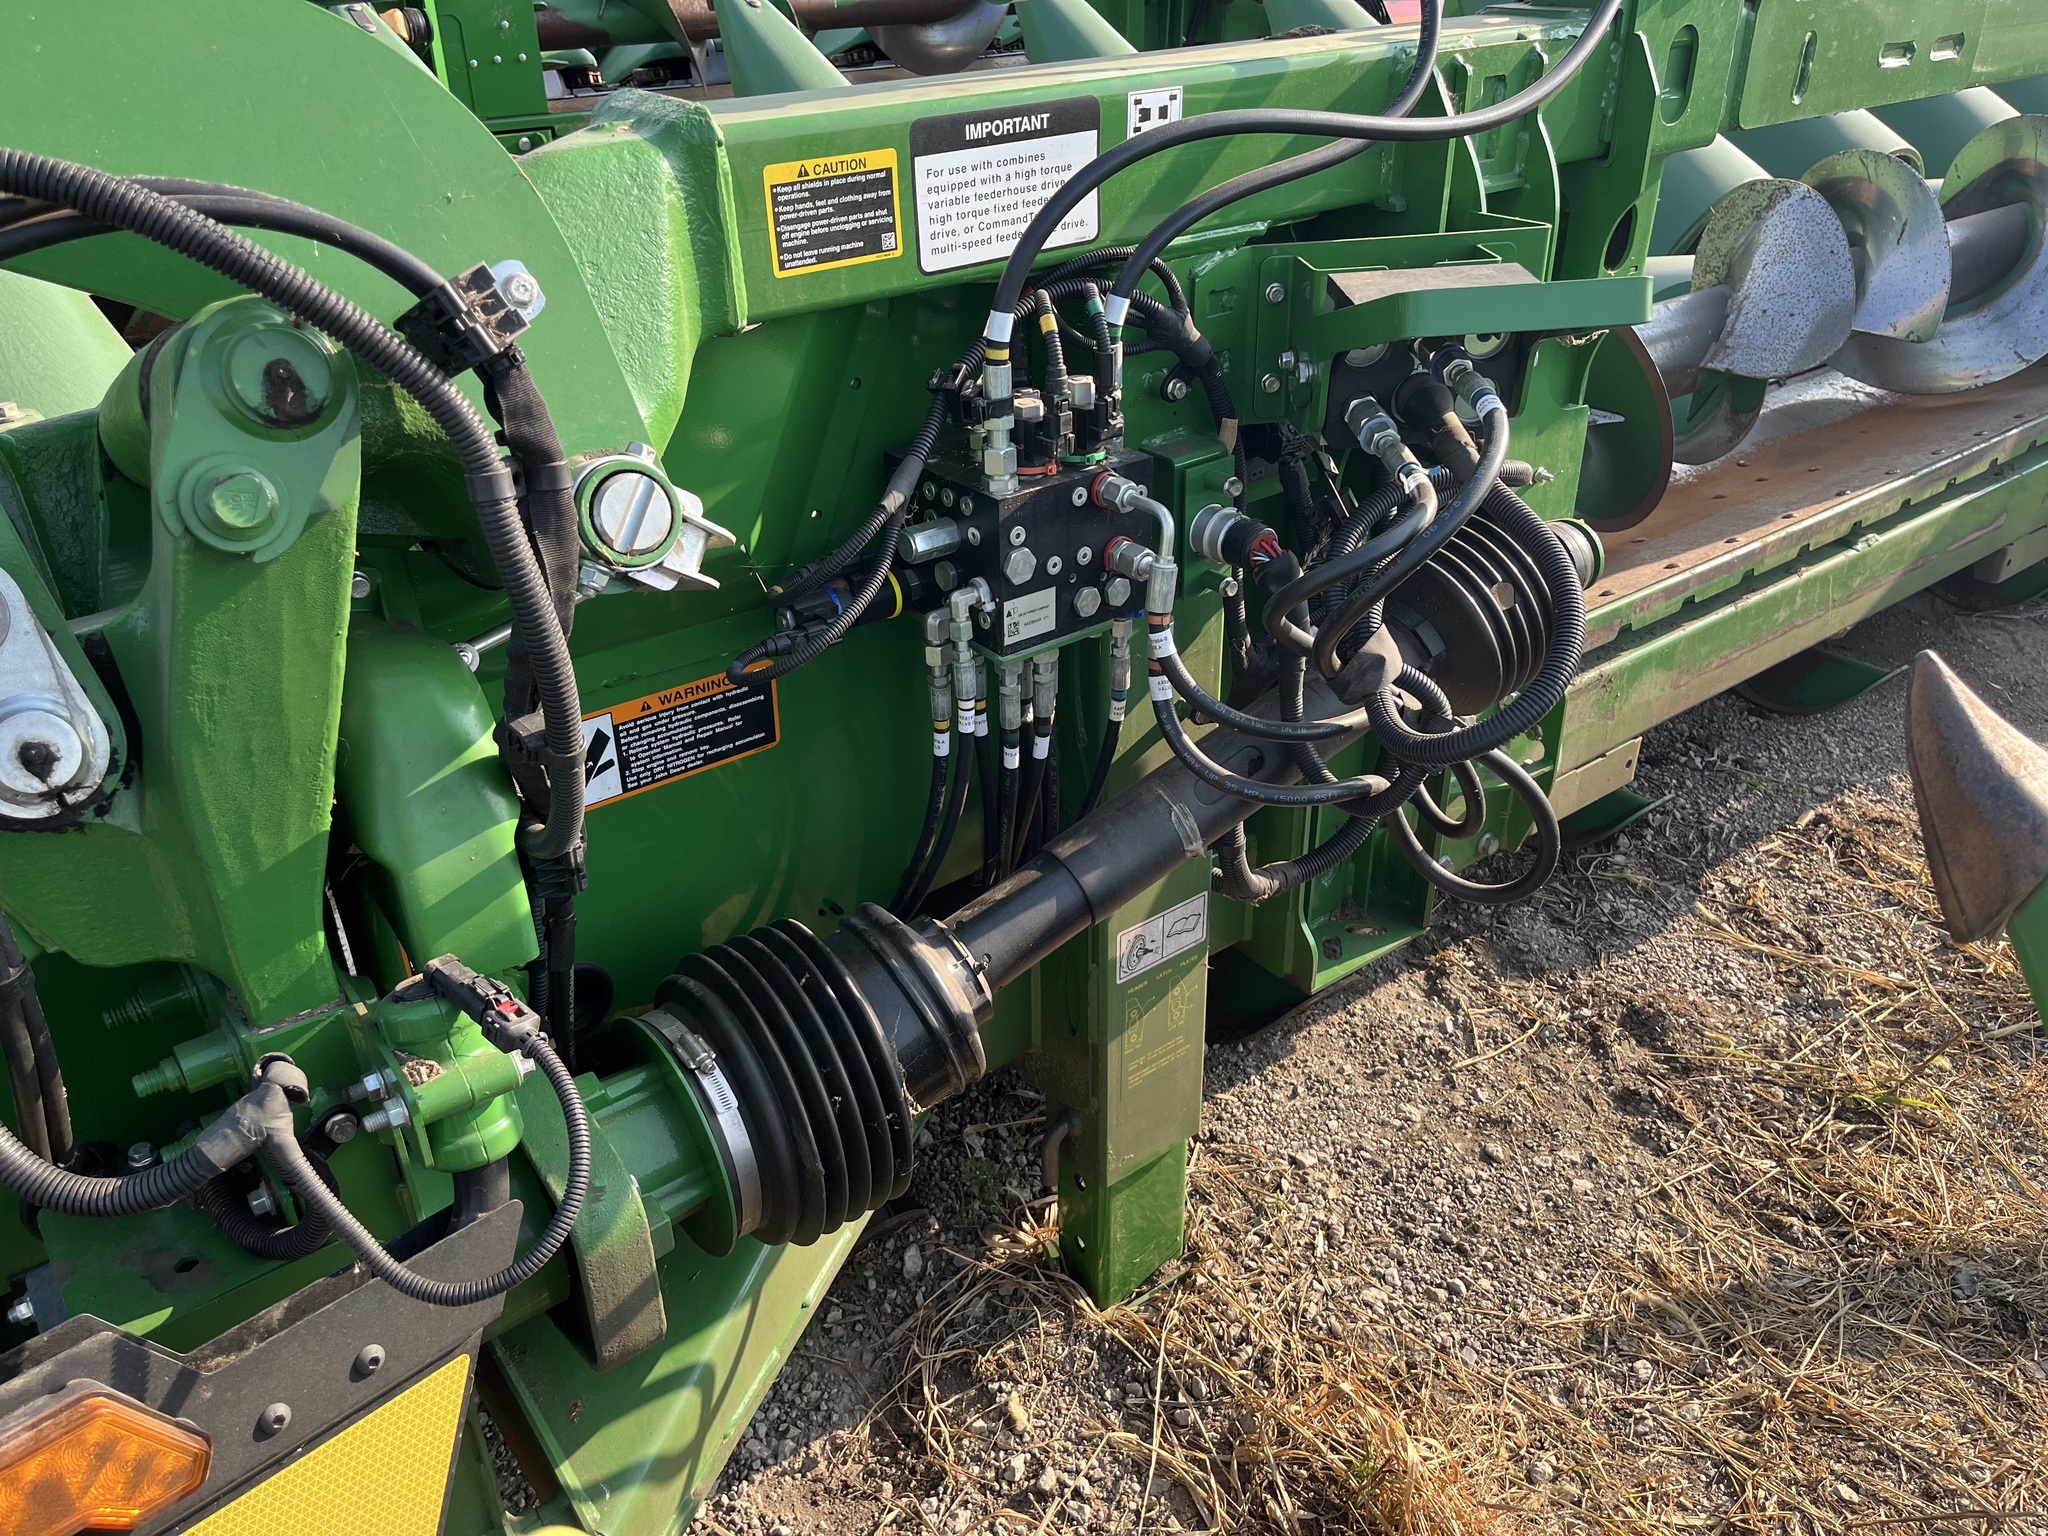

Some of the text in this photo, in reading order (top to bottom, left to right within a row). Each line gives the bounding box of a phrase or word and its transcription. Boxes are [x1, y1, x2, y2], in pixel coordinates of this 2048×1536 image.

[965, 113, 1050, 141] IMPORTANT
[813, 158, 867, 176] CAUTION
[926, 152, 1046, 179] For use with combines
[926, 162, 1073, 195] equipped with a high torque
[777, 186, 792, 194] Keep
[801, 180, 823, 190] shields
[830, 178, 846, 187] place
[847, 174, 865, 182] during
[866, 170, 886, 180] normal
[777, 191, 811, 202] operations.
[795, 201, 815, 210] hands,
[827, 197, 838, 205] and
[839, 194, 862, 203] clothing
[863, 191, 877, 199] away
[878, 189, 891, 197] from
[928, 194, 970, 210] variable
[974, 184, 1038, 202] feederhouse
[779, 207, 835, 222] power-driven parts.
[780, 208, 888, 233] Disengage power-driven parts and shut
[928, 213, 953, 226] high
[956, 208, 990, 222] torque
[993, 202, 1019, 214] fixed
[930, 212, 1036, 242] drive, or CommandT
[781, 215, 893, 240] off engine before unclogging or servicing
[931, 237, 992, 256] multi-speed
[1060, 218, 1088, 231] drive.
[782, 238, 809, 248] machine.
[792, 251, 803, 259] not
[803, 248, 818, 257] leave
[818, 244, 840, 255] running
[840, 240, 864, 250] machine
[784, 257, 818, 268] unattended.
[1422, 524, 1438, 538] 06
[619, 721, 634, 731] Avoid
[637, 715, 657, 725] serious
[659, 709, 674, 719] injury
[676, 705, 690, 713] from
[690, 698, 711, 708] contact
[725, 686, 749, 697] hydraulic
[621, 735, 639, 744] Before
[641, 726, 667, 738] removing
[668, 718, 693, 729] hydraulic
[728, 694, 765, 709] disassembling
[1214, 702, 1227, 715] EN
[1229, 711, 1247, 724] 857
[1280, 724, 1294, 734] DN
[628, 745, 649, 755] Relieve
[650, 738, 670, 748] system
[671, 729, 696, 741] hydraulic
[697, 721, 724, 733] pressures.
[727, 714, 742, 723] Refer
[629, 726, 640, 735] and
[641, 723, 652, 731] gas
[654, 717, 670, 727] under
[671, 710, 697, 722] pressure.
[630, 736, 655, 748] changing
[637, 747, 662, 759] Operator
[663, 740, 683, 750] Manual
[696, 730, 714, 739] Repair
[715, 723, 734, 733] Manual
[653, 765, 665, 774] DRY
[666, 755, 696, 769] NITROGEN
[706, 743, 734, 756] recharging
[734, 732, 767, 746] accumulator.
[630, 747, 684, 768] system information.
[631, 766, 645, 774] Stop
[646, 759, 665, 769] engine
[678, 748, 698, 758] remove
[1159, 711, 1176, 737] 3/8"
[1181, 751, 1201, 770] MAX
[1223, 780, 1239, 792] 35
[1244, 787, 1265, 800] MPa
[1273, 794, 1308, 804] (5000
[1314, 791, 1338, 802] PSI)
[639, 776, 653, 785] your
[654, 771, 668, 780] John
[669, 765, 686, 775] Deere
[686, 759, 705, 768] dealer.
[1127, 954, 1199, 995] HEADER LATCH PLATES
